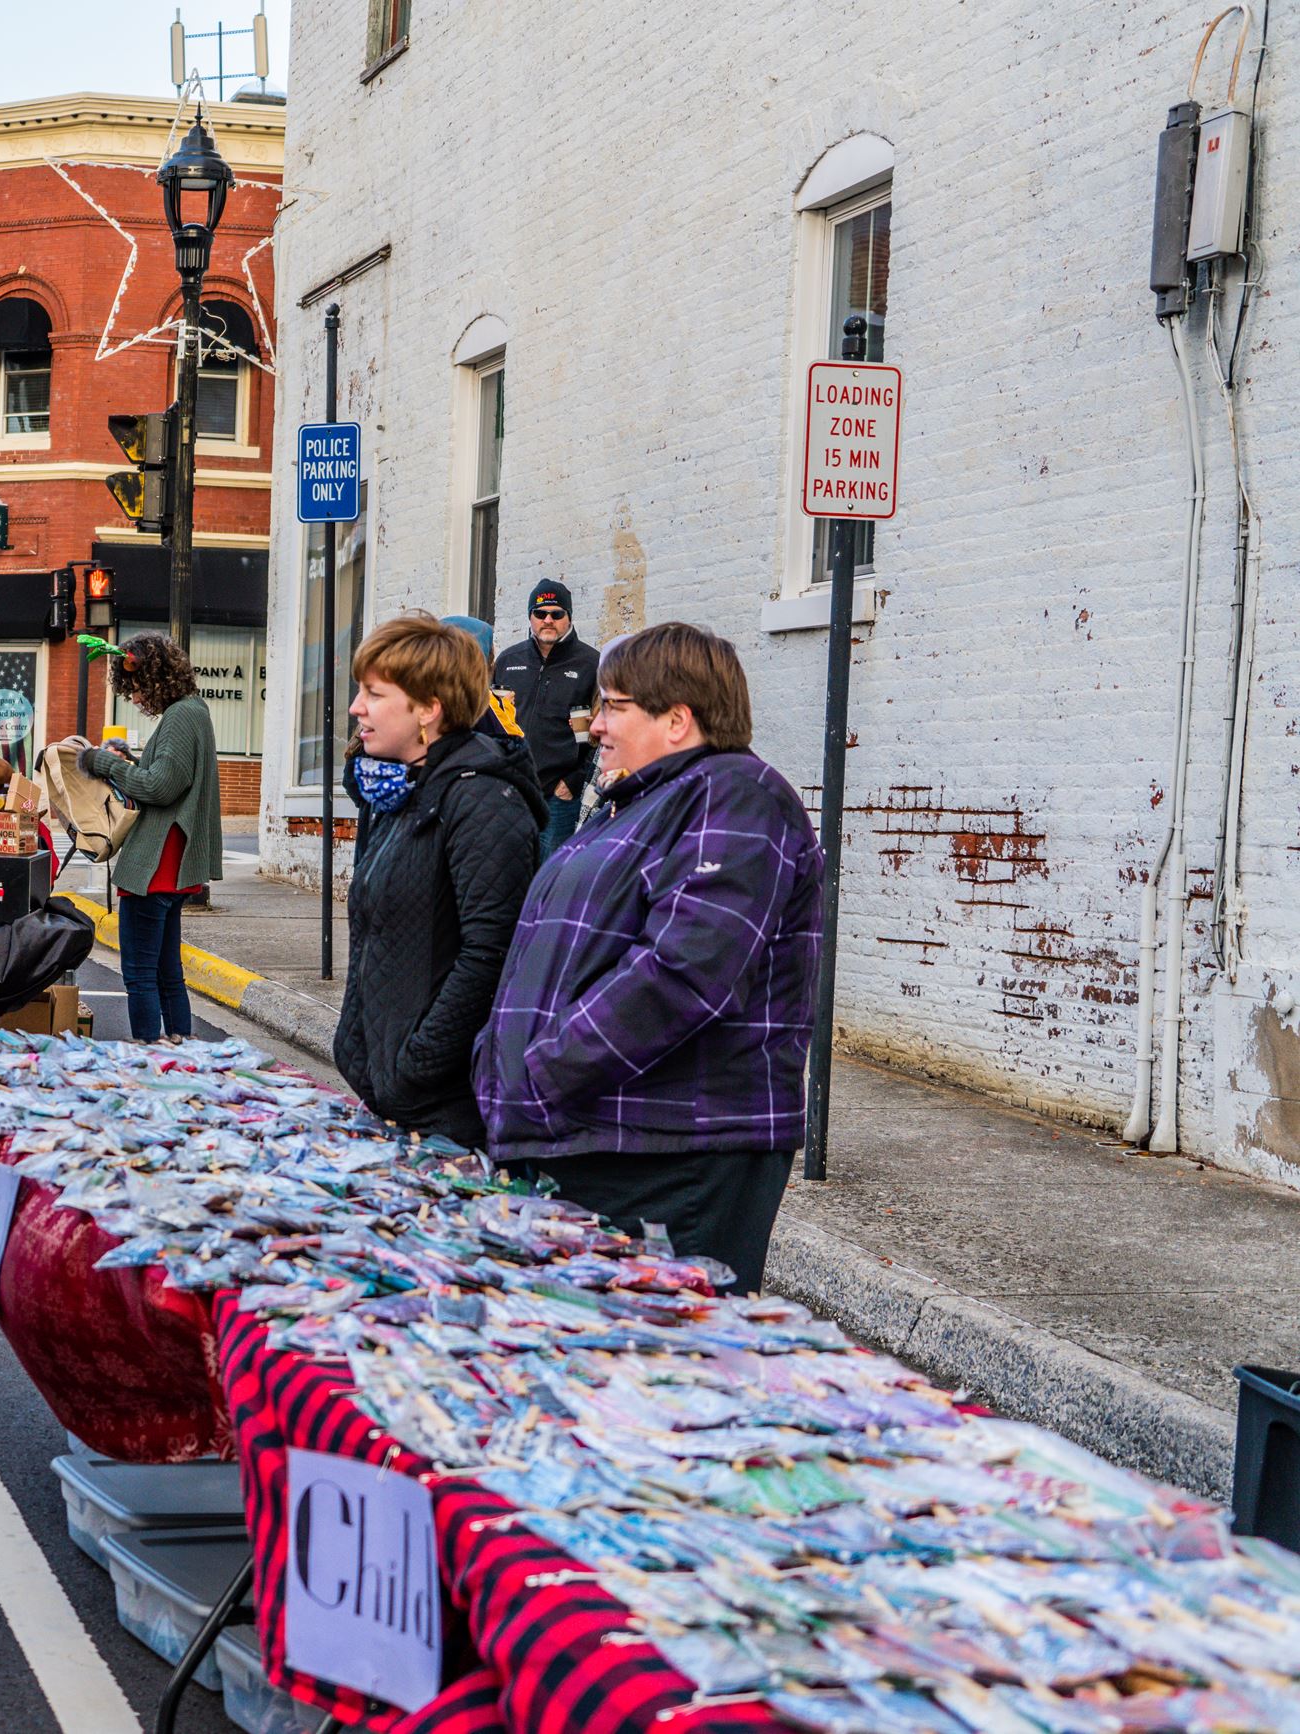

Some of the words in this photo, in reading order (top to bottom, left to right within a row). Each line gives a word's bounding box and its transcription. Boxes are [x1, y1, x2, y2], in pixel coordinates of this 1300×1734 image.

[816, 384, 893, 407] LOADING
[830, 417, 876, 438] ZONE
[306, 437, 350, 458] POLICE
[825, 448, 841, 468] 15
[850, 449, 880, 469] MIN
[303, 460, 356, 480] PARKING
[312, 482, 345, 502] ONLY
[813, 478, 888, 501] PARKING
[193, 666, 229, 678] PANY
[233, 664, 243, 678] A
[10, 710, 26, 718] Boys
[5, 723, 28, 731] Center
[295, 1478, 433, 1650] Child
